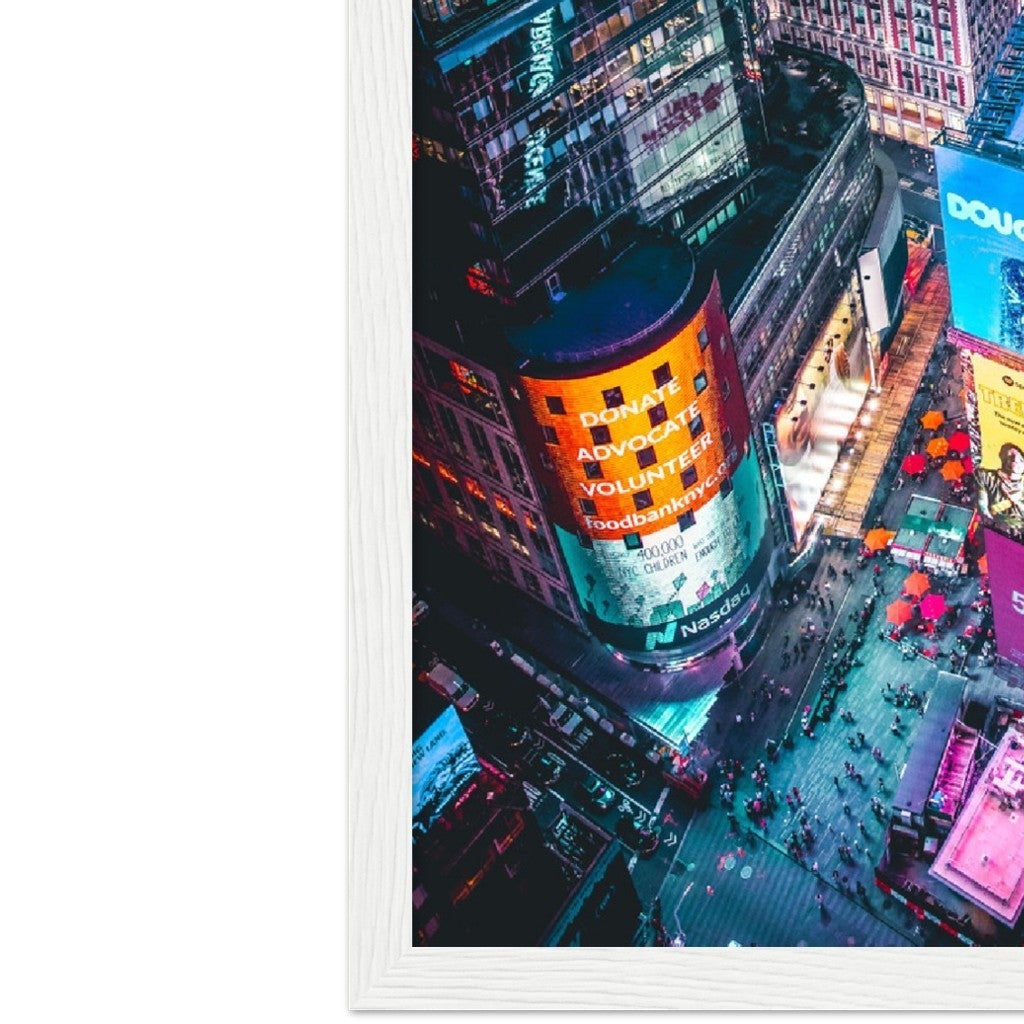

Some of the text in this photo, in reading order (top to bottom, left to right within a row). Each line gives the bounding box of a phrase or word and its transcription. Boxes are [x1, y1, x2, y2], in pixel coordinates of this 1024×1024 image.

[579, 376, 682, 429] DONATE
[576, 400, 702, 462] ADVOCATE
[579, 431, 714, 497] VOLUNTEER
[643, 549, 688, 574] CHILDREN
[680, 583, 751, 638] Nasdaq
